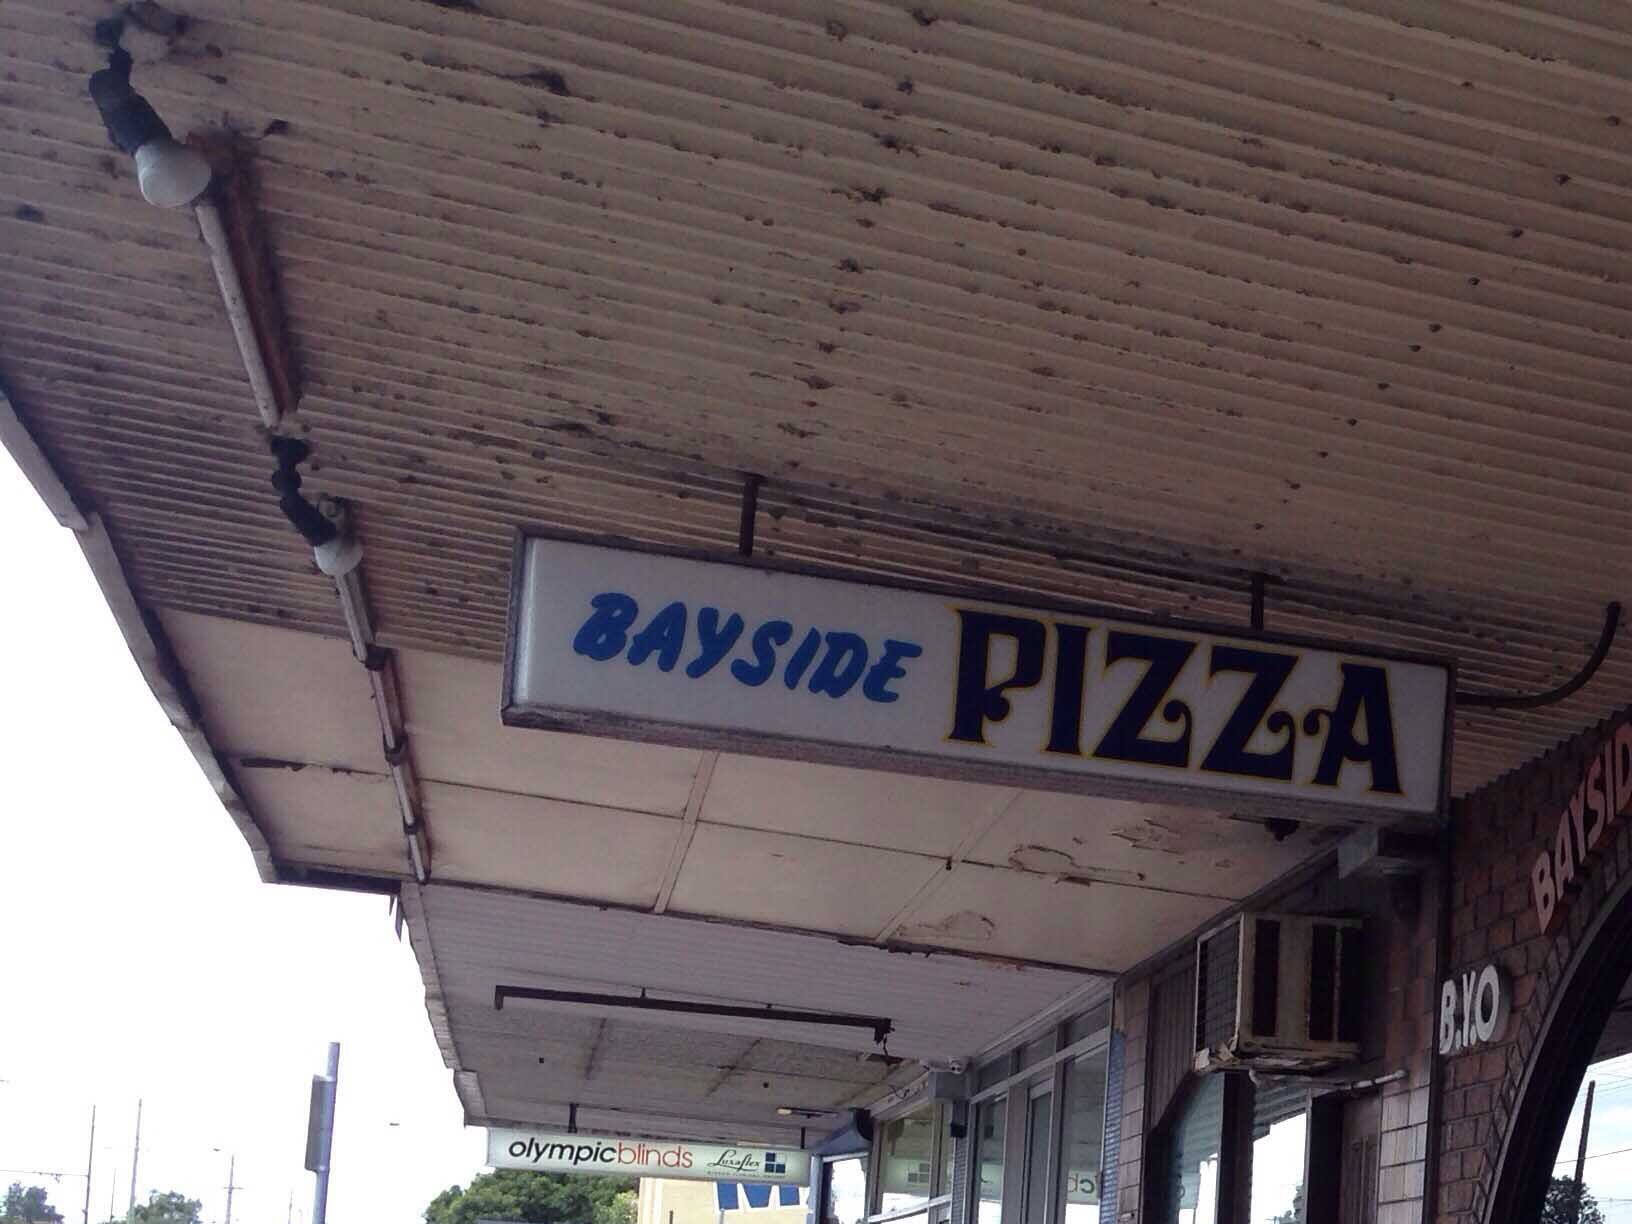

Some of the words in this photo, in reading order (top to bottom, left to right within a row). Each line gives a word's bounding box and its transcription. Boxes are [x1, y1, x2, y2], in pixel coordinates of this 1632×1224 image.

[571, 590, 923, 706] BAYSIDE
[946, 605, 1405, 796] PIZZA
[1439, 964, 1500, 1055] B.Y.O
[508, 1136, 694, 1169] olympicblinds
[707, 1148, 761, 1172] Luxaflex
